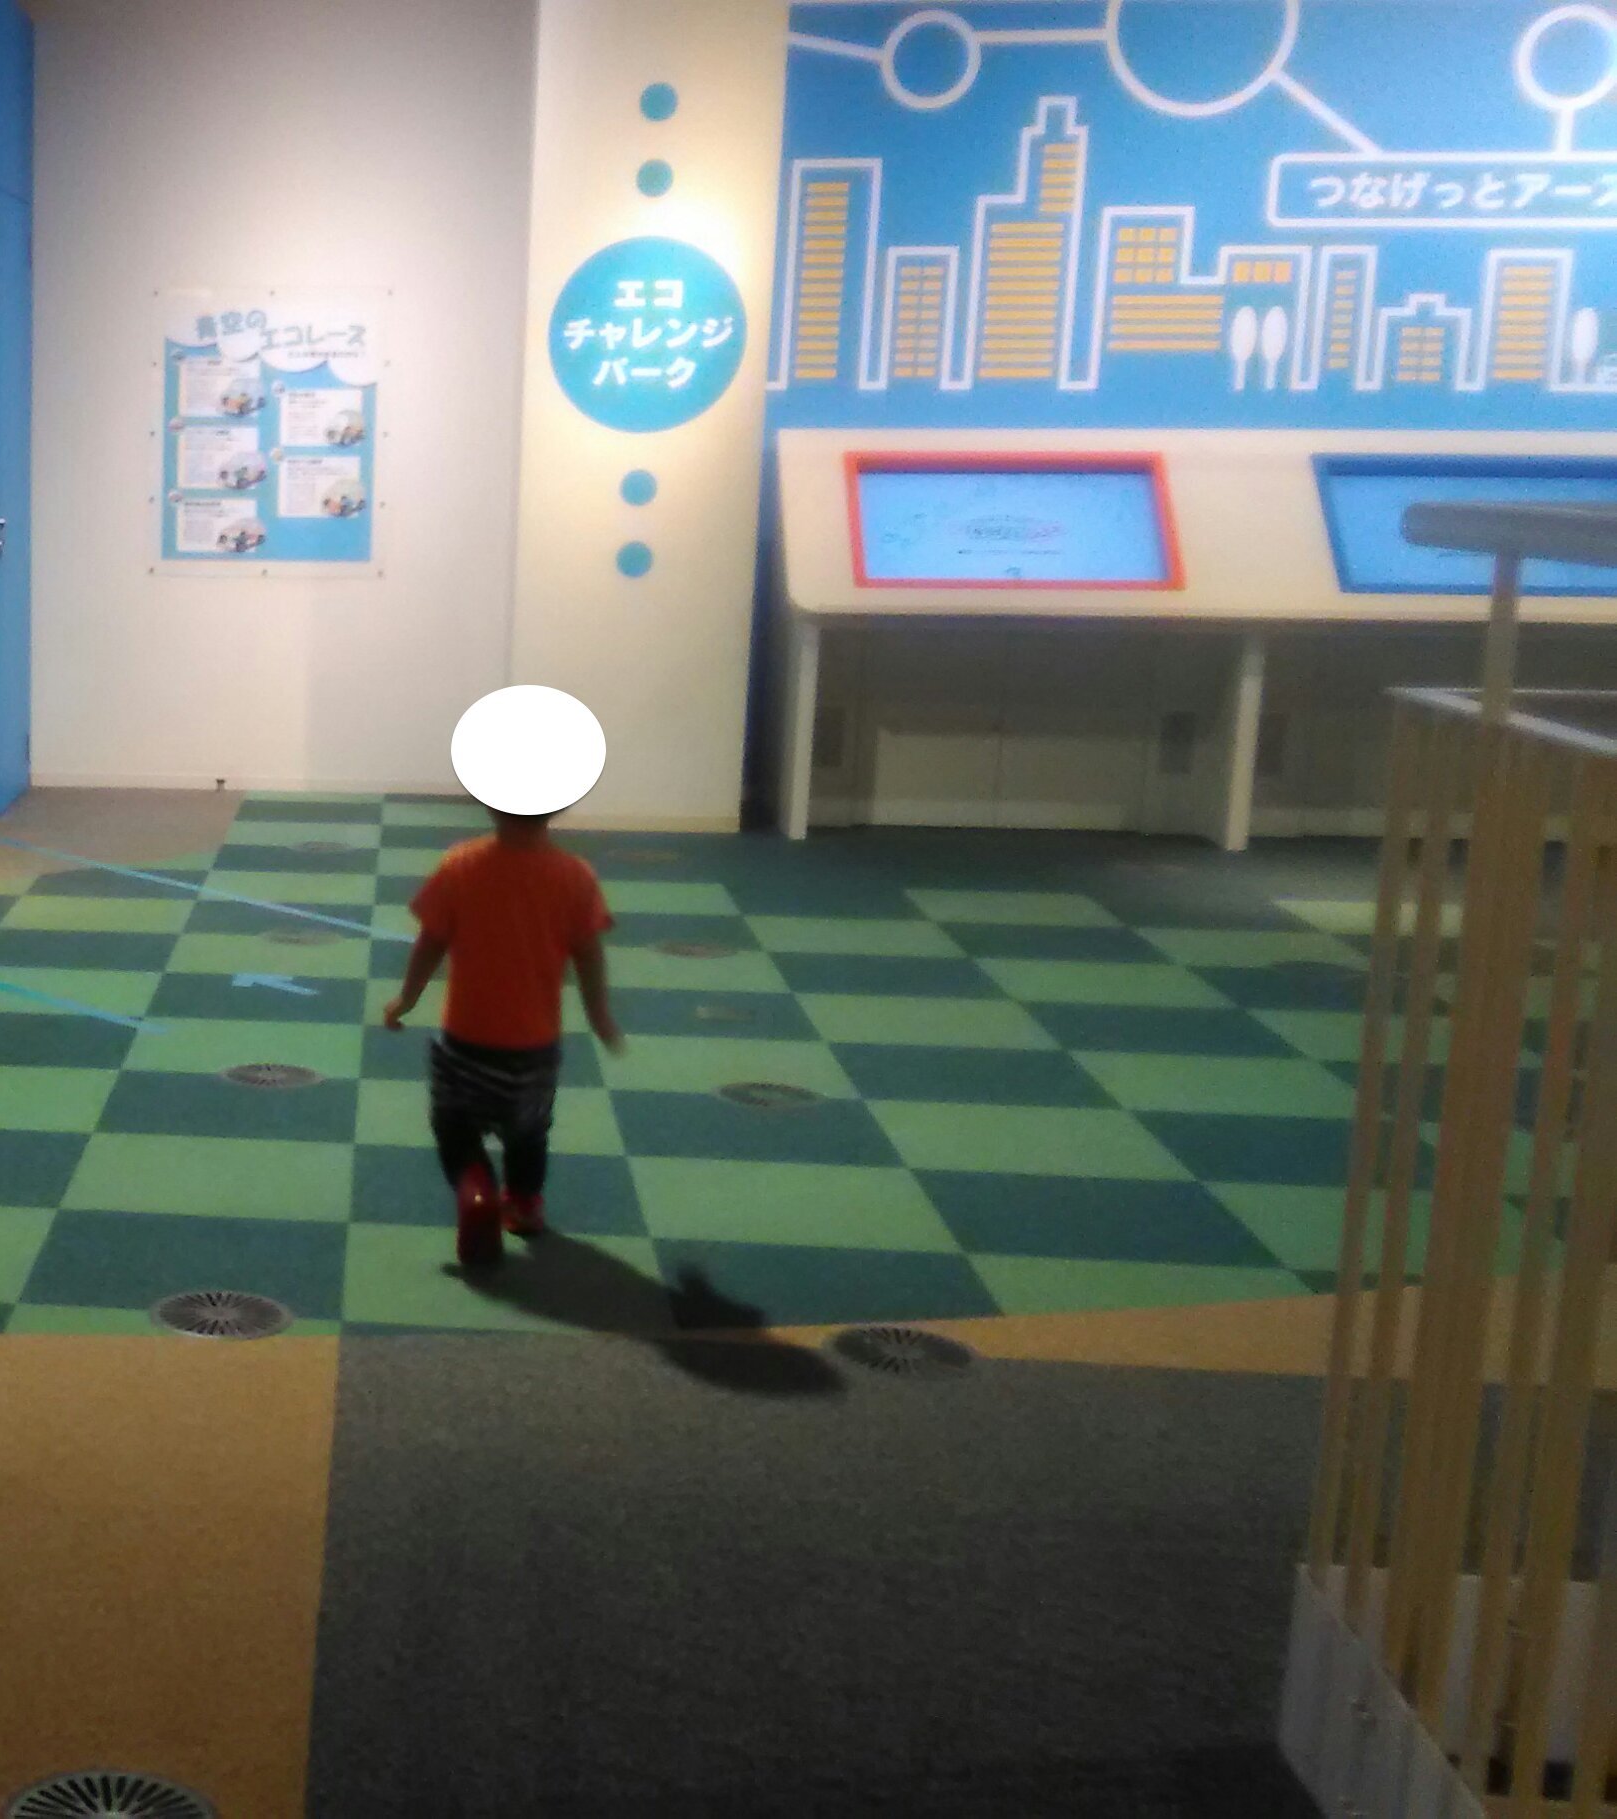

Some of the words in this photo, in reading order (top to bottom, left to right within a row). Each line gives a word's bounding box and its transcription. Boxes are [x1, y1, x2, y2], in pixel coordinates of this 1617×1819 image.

[614, 280, 683, 308] エコ
[563, 317, 734, 350] チャレンジ
[592, 357, 697, 389] パーク
